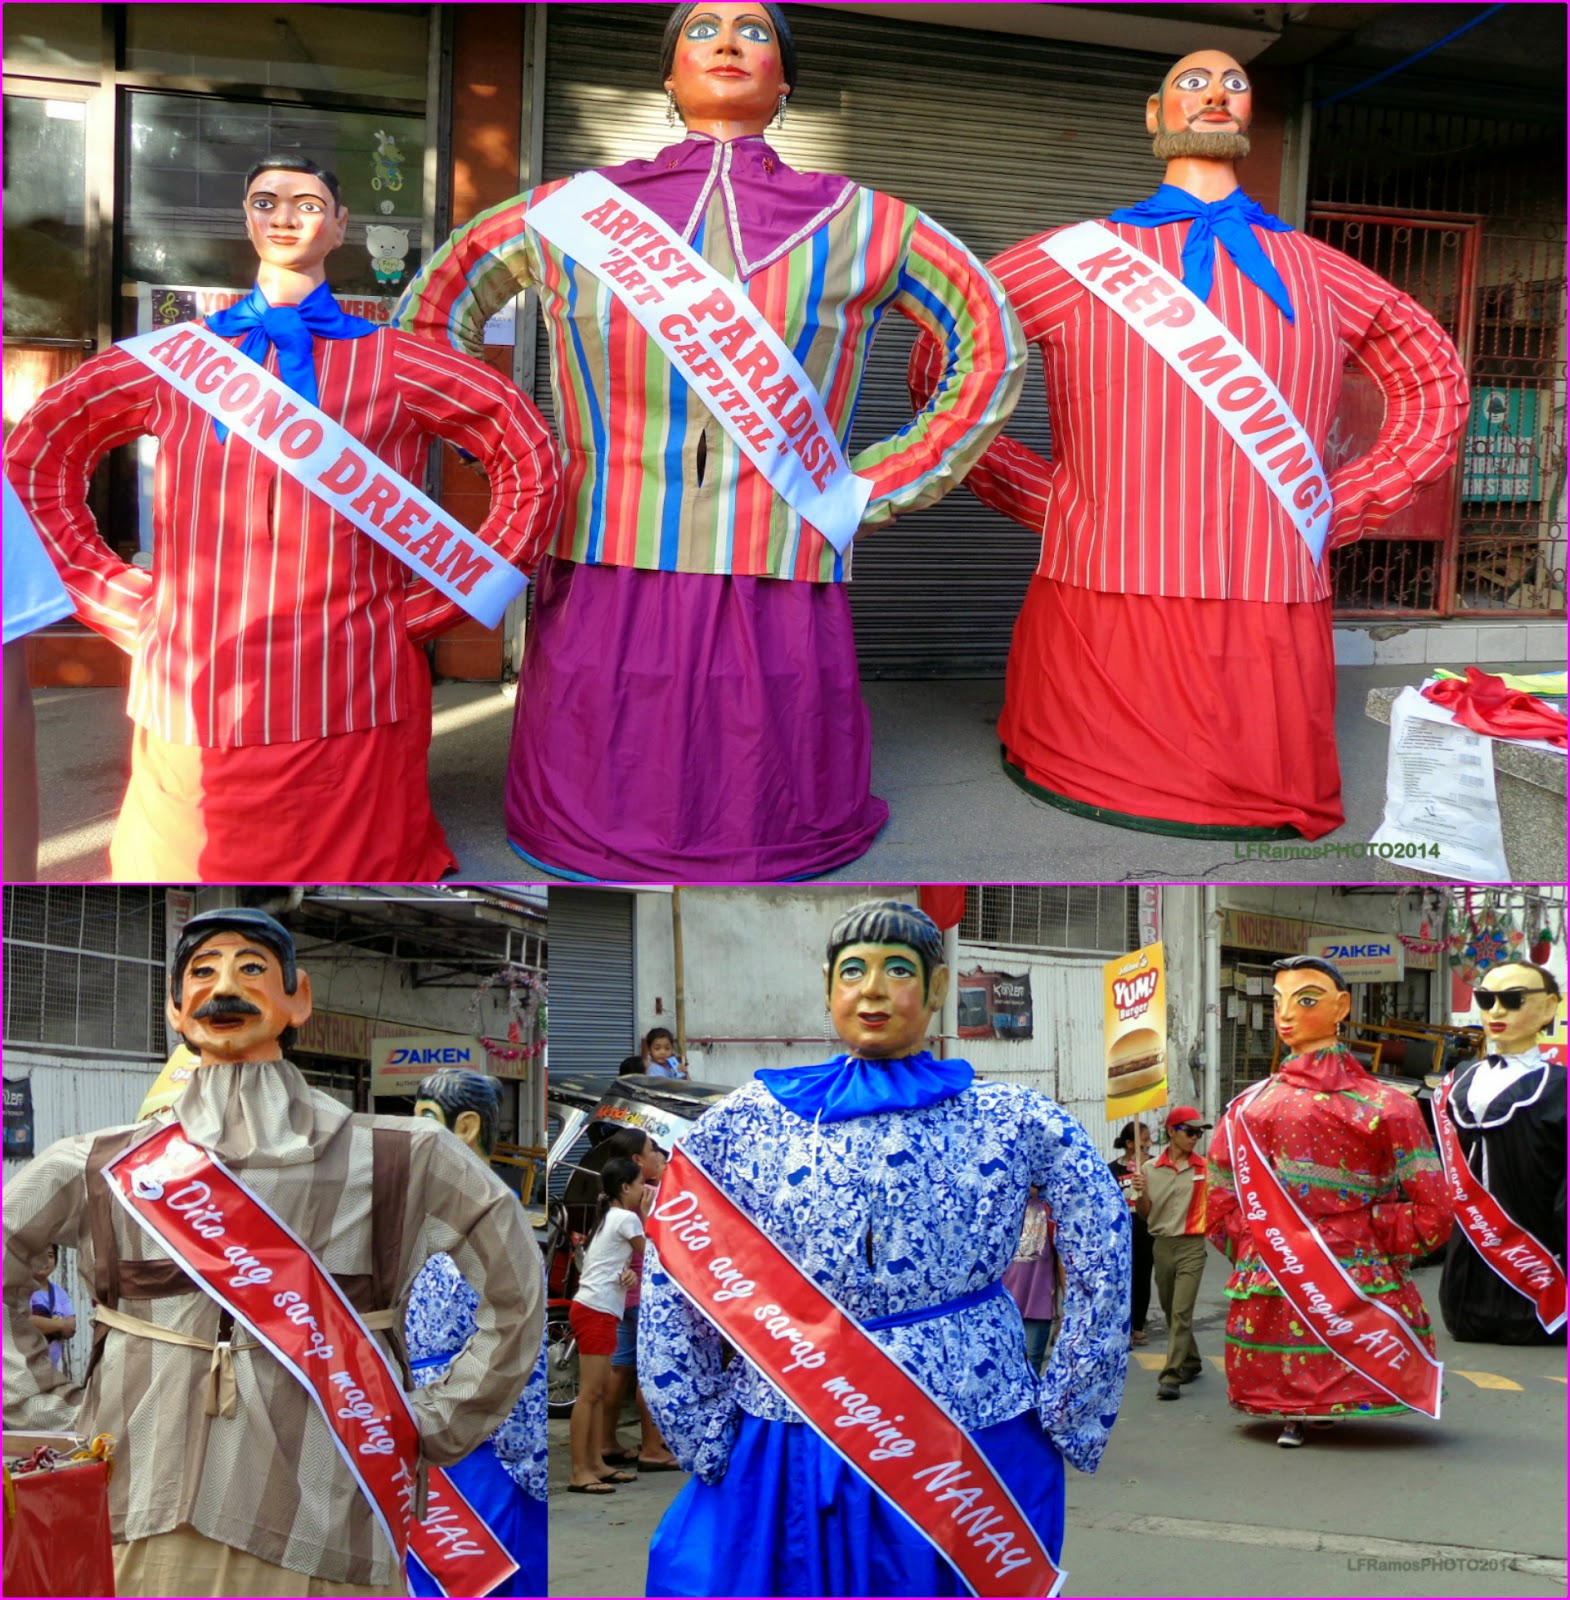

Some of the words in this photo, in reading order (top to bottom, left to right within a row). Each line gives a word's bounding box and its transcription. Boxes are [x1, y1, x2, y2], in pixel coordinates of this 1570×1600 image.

[582, 198, 706, 289] ARTIST
[689, 287, 838, 494] PARADISE
[600, 248, 664, 305] "ART
[659, 313, 788, 456] CAPITAL"
[1077, 246, 1196, 330] KEEP
[1178, 335, 1332, 528] MOVING!
[148, 330, 324, 460] ANGONO
[318, 448, 494, 596] DREAM
[387, 1048, 470, 1065] DAIKEN
[1114, 971, 1157, 1008] YUM!
[1119, 1002, 1149, 1020] Burger
[1321, 944, 1391, 959] DAIKEN
[166, 1180, 225, 1239] Dito
[224, 1245, 273, 1288] ang
[273, 1290, 334, 1360] sarap
[329, 1370, 395, 1455] maging
[1237, 1144, 1251, 1185] Dito
[1247, 1191, 1267, 1221] ang
[1265, 1227, 1304, 1275] sarap
[1300, 1281, 1353, 1337] maging
[1353, 1328, 1411, 1370] ATE
[1465, 1206, 1503, 1248] maging
[654, 1190, 712, 1251] Dito
[708, 1257, 756, 1302] ang
[754, 1304, 827, 1374] sarap
[822, 1375, 916, 1461] maging
[912, 1460, 1032, 1579] NANAY
